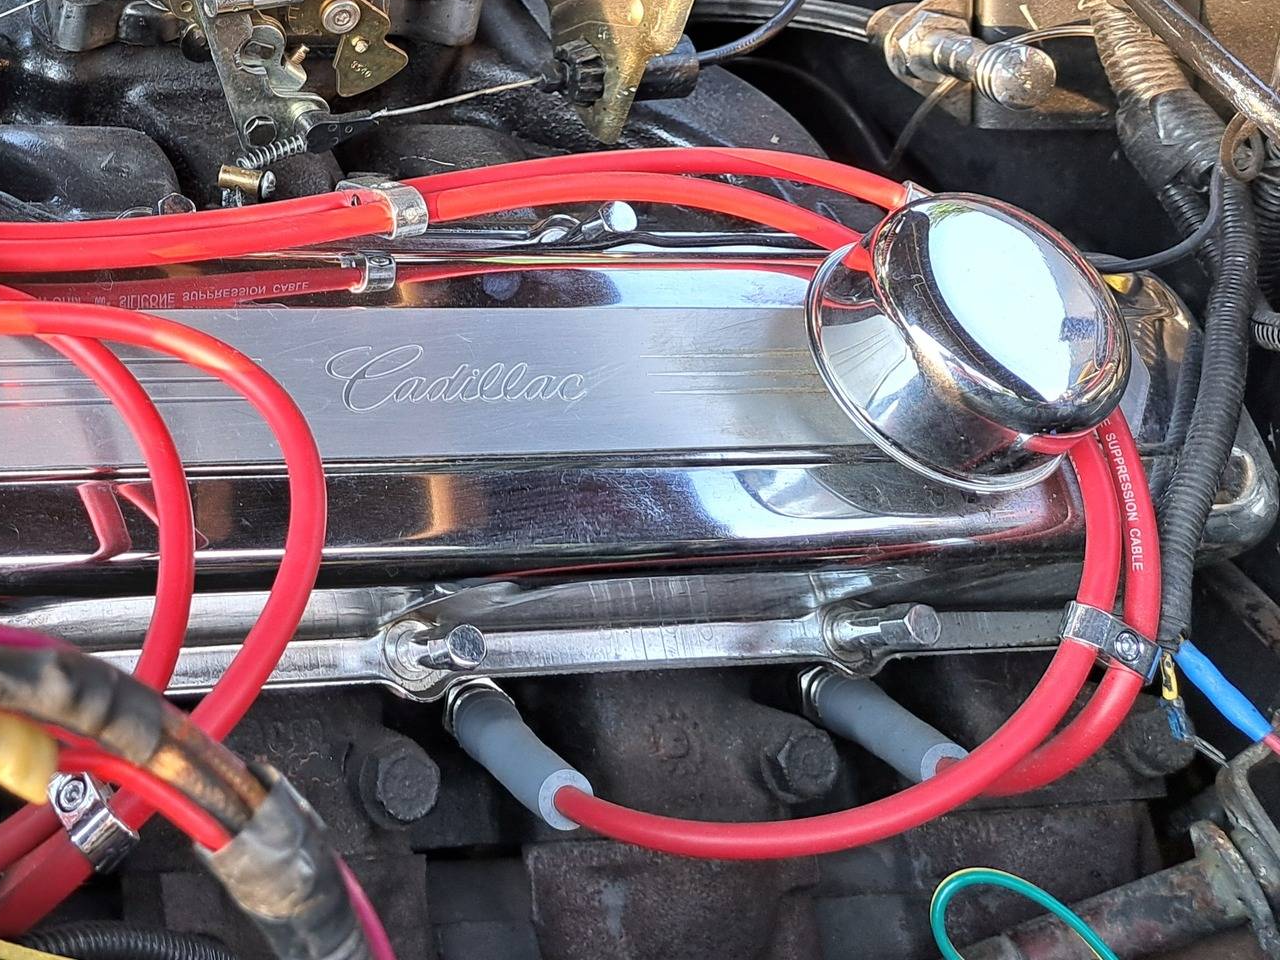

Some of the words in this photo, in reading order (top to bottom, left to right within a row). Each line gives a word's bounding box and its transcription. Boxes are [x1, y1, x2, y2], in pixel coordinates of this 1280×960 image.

[324, 343, 588, 414] Cadillac
[1104, 432, 1139, 523] SUPPRESSION
[1129, 527, 1144, 573] CABLE
